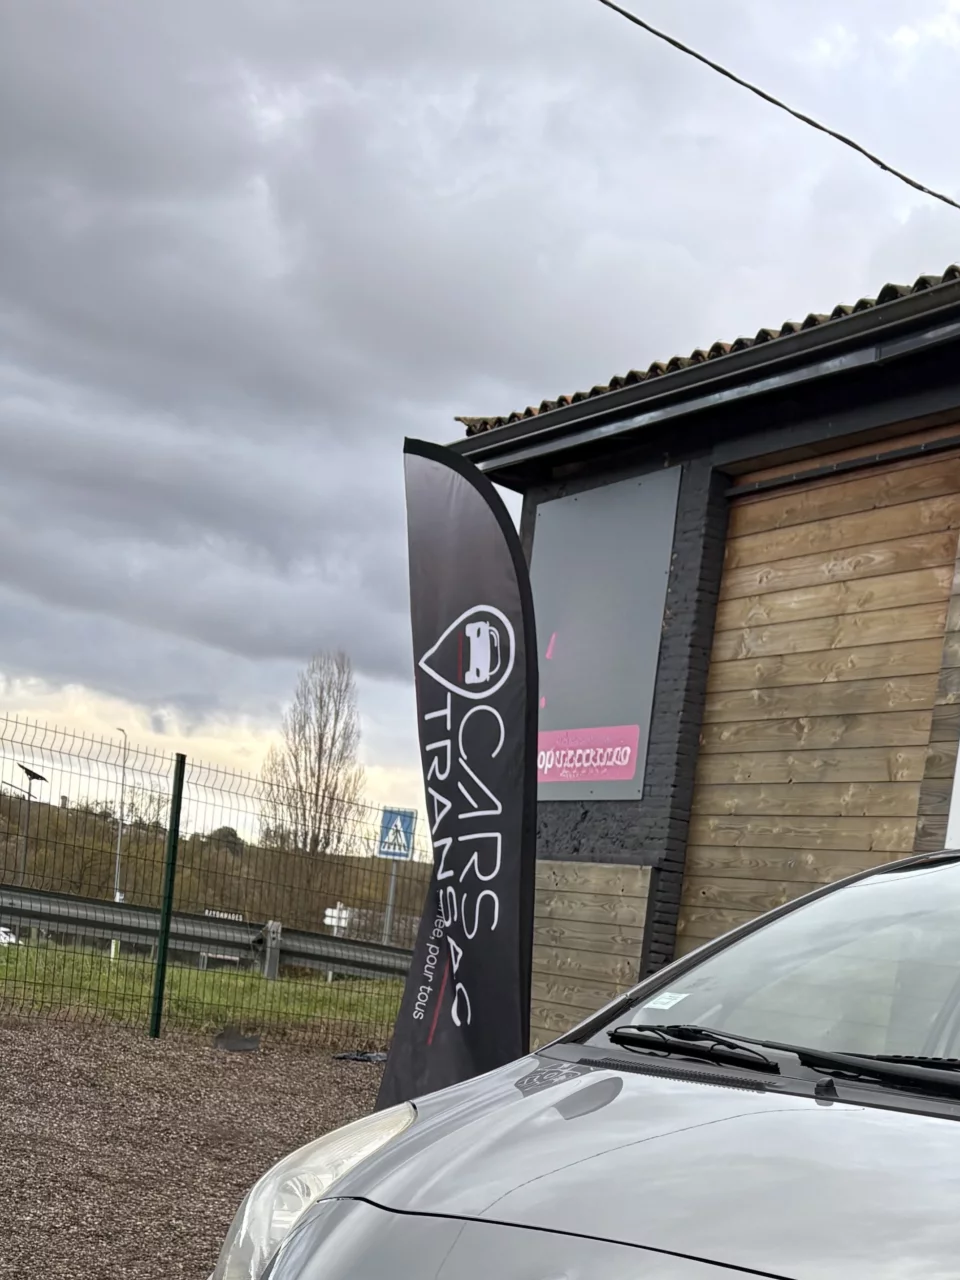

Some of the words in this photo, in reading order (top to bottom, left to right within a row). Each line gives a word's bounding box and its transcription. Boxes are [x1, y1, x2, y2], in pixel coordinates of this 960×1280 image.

[424, 691, 471, 1027] TRANSAC
[458, 704, 505, 940] CARS
[412, 985, 433, 1020] tous
[426, 943, 440, 982] pour
